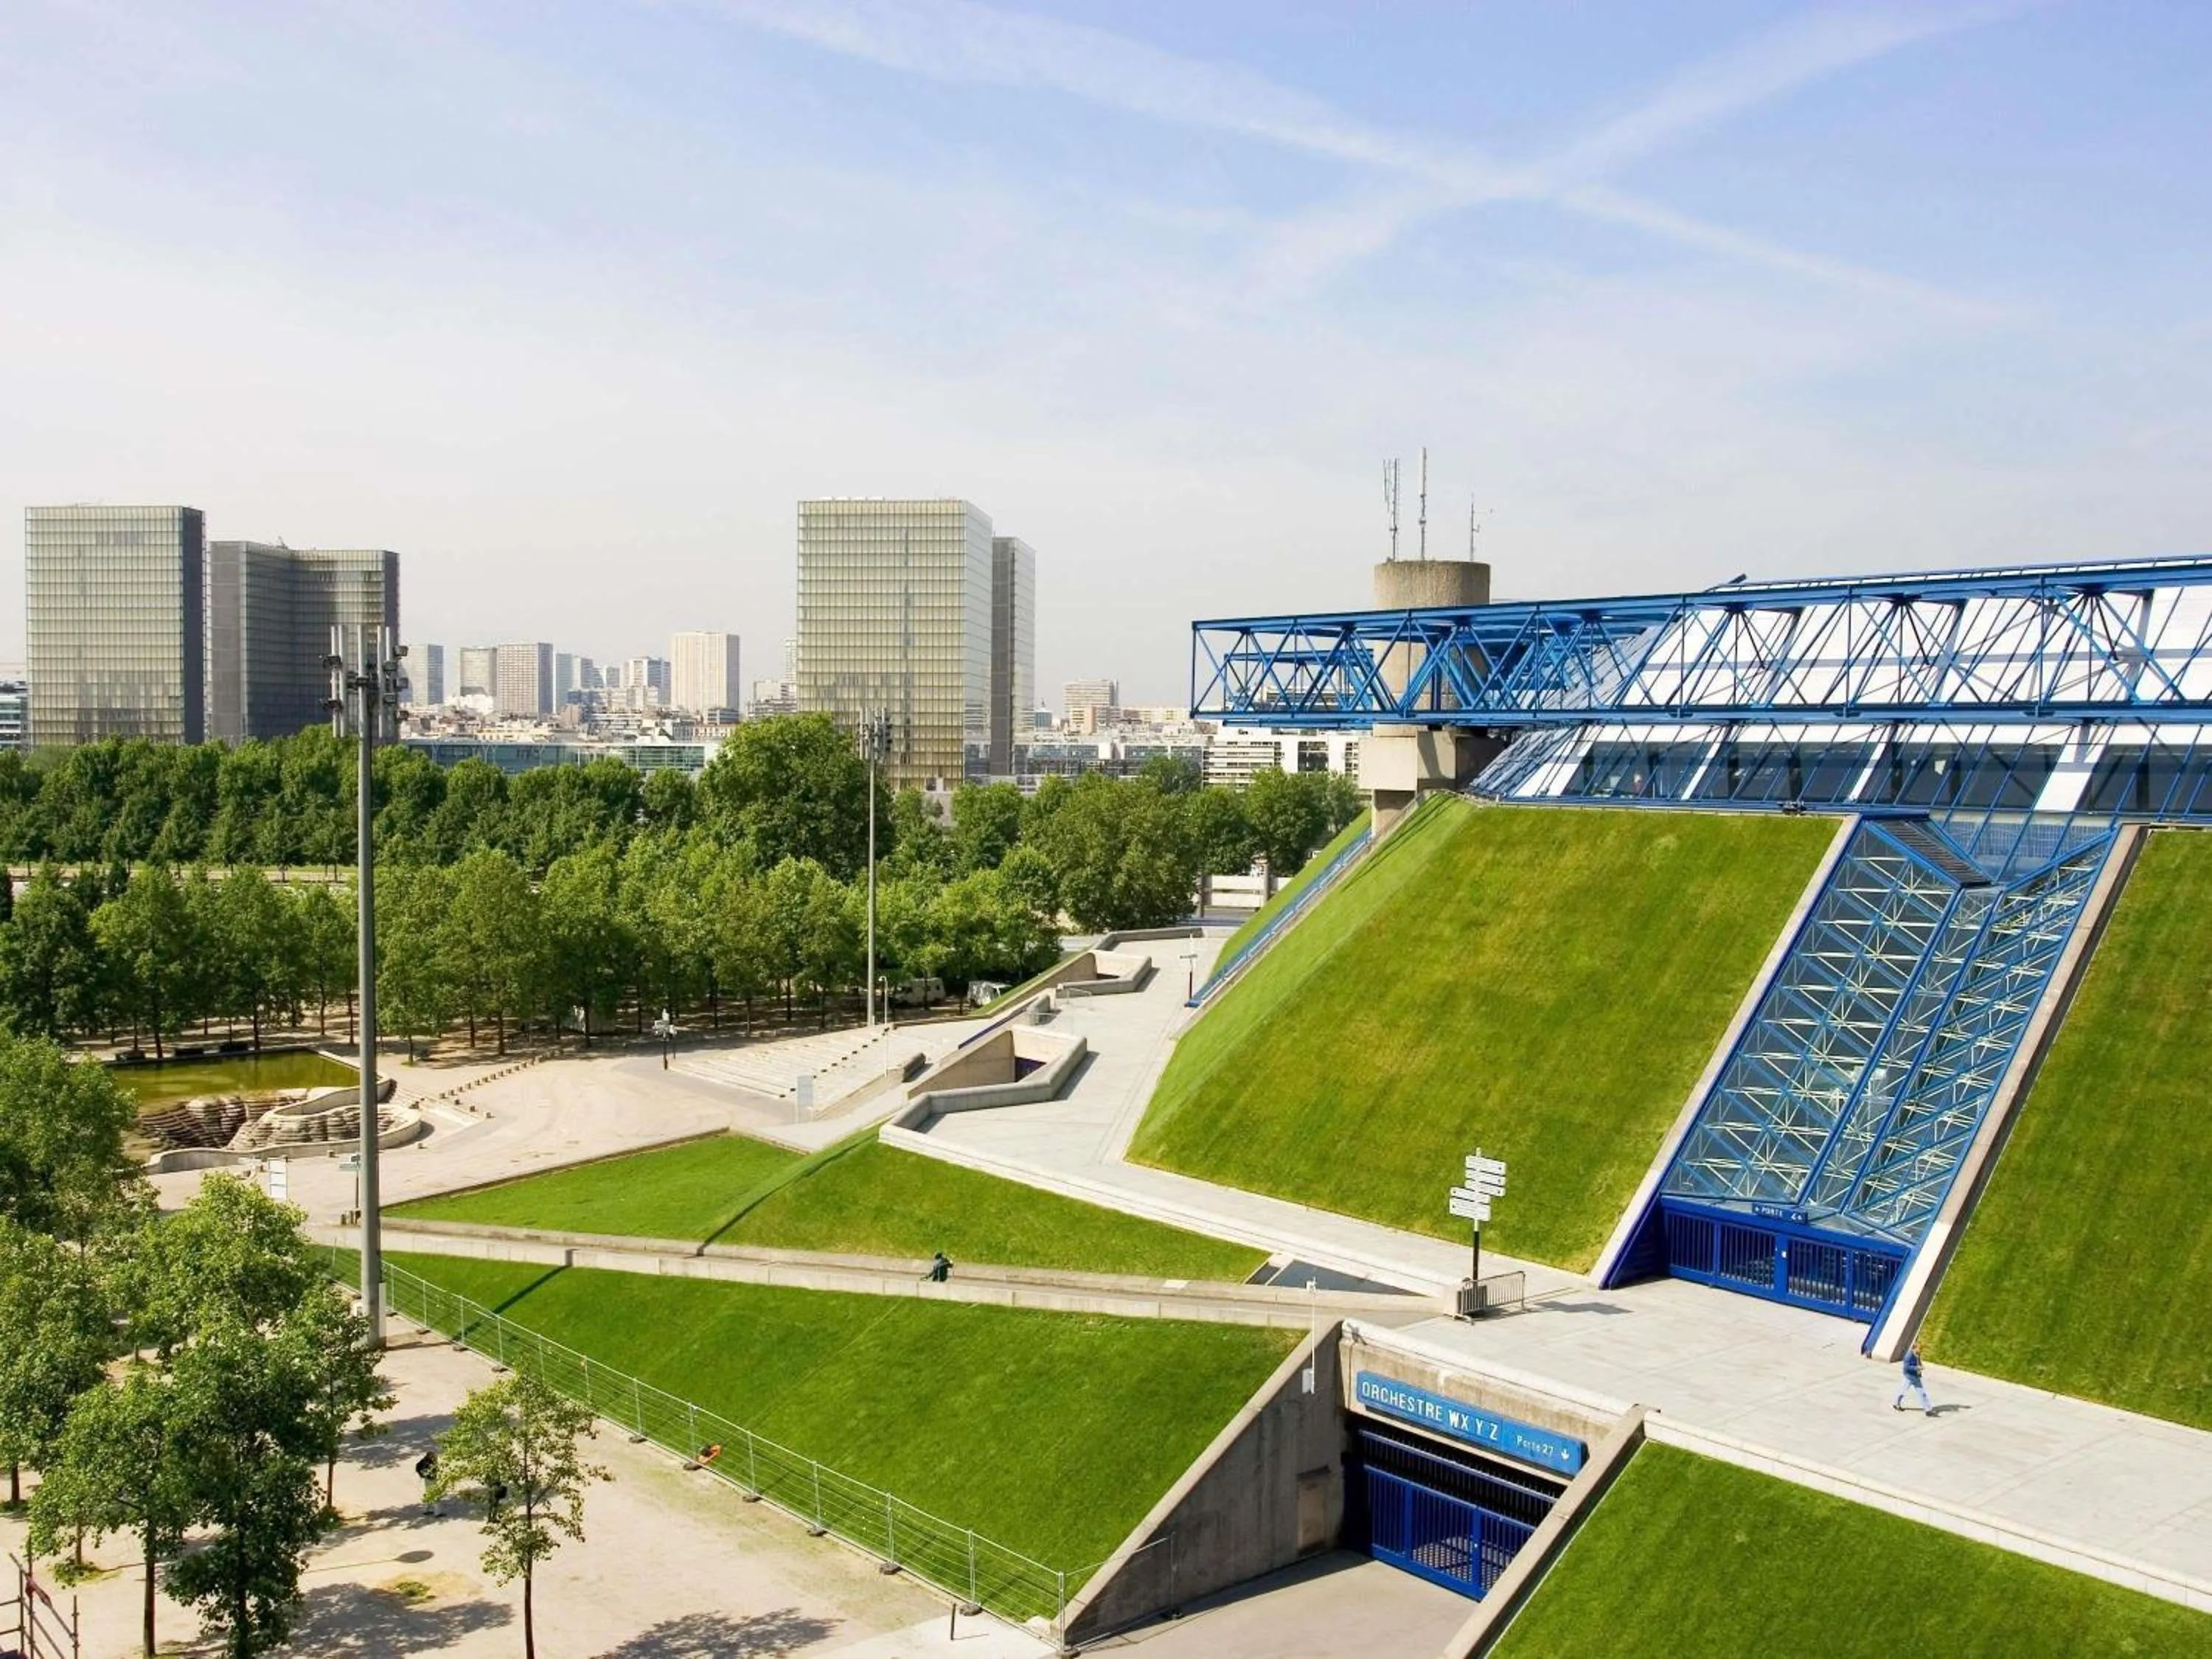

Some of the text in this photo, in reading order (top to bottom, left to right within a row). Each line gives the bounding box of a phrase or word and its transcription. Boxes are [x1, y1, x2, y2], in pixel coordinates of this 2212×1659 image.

[1362, 1381, 1443, 1422] ORCHESTRE
[1475, 1418, 1484, 1435] Y
[1489, 1422, 1498, 1441] Z
[1542, 1443, 1554, 1458] 27
